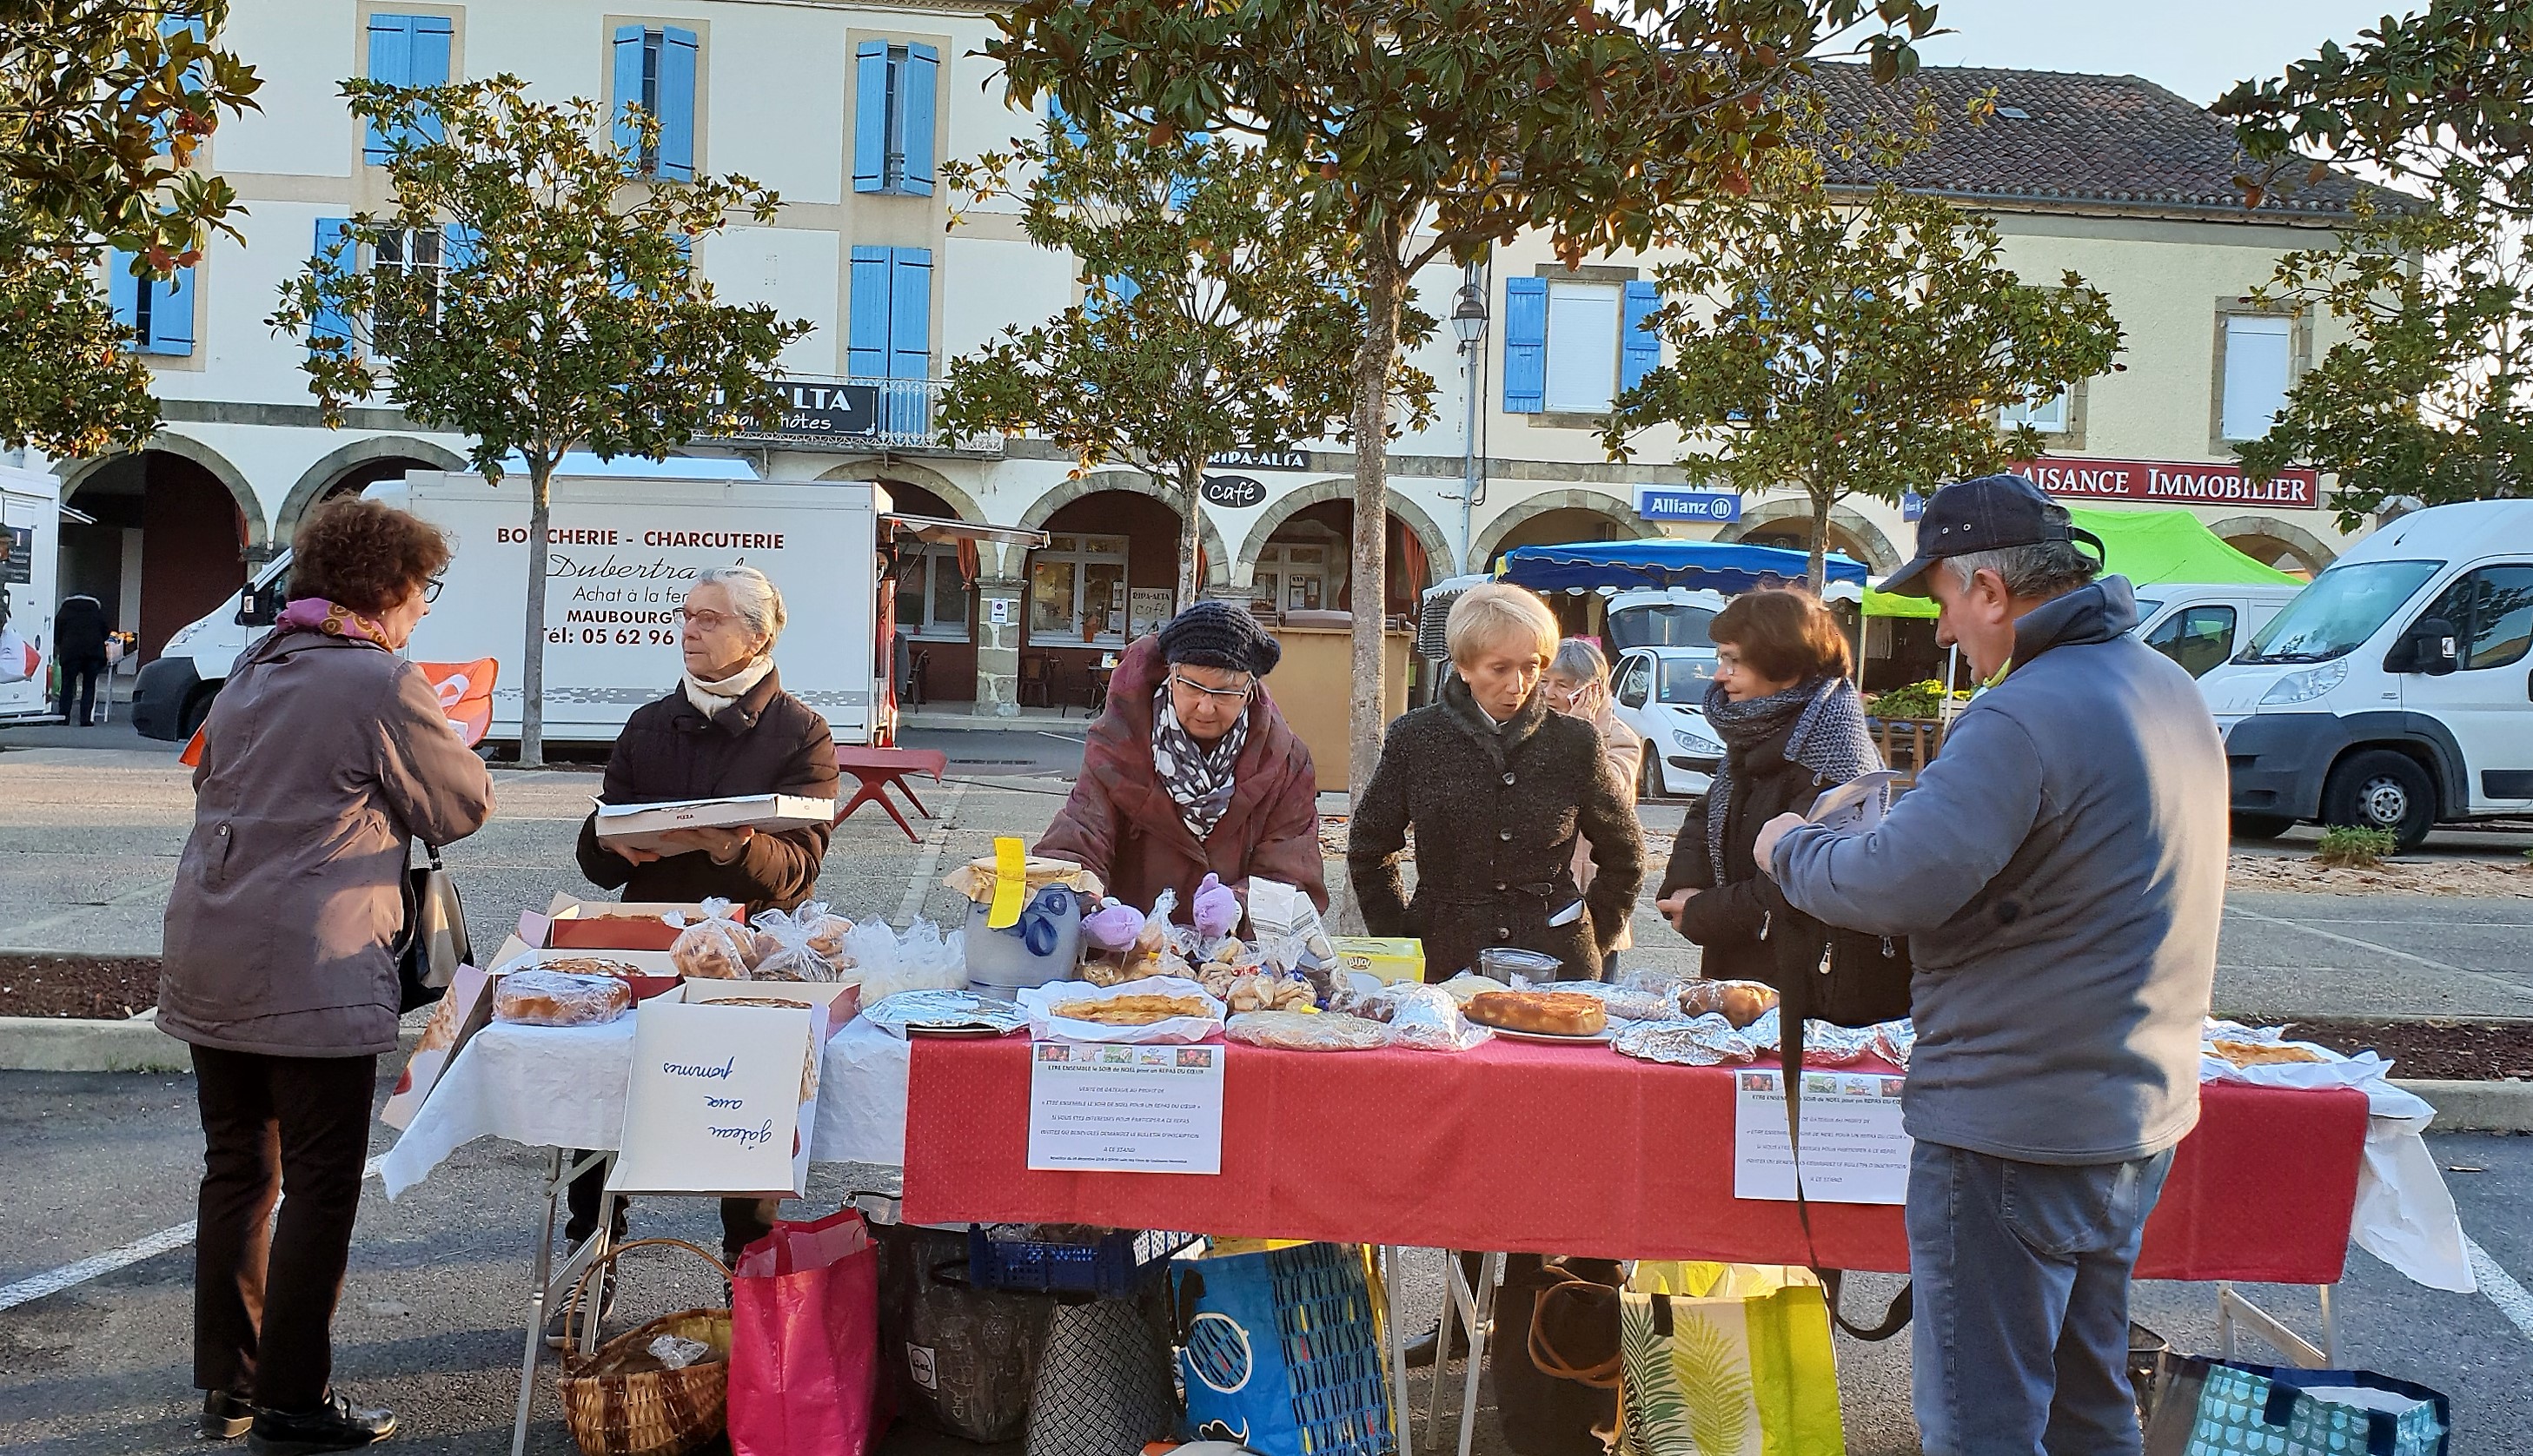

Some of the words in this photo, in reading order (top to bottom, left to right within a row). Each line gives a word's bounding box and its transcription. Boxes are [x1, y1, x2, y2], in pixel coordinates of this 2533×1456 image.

[1209, 481, 1255, 506] café
[2147, 468, 2308, 501] IMMOBILIER
[1651, 498, 1708, 514] Allianz
[497, 528, 618, 546] BOCHERIE
[644, 531, 785, 549] CHARCUTERIE
[546, 554, 745, 579] Dubertra
[573, 586, 623, 604] Achat
[627, 588, 638, 603] à
[644, 586, 659, 603] la
[666, 586, 689, 604] fer
[567, 610, 673, 625] MAUBOURG
[582, 628, 607, 645] 05
[615, 629, 640, 645] 62
[648, 629, 674, 645] 96
[663, 1056, 735, 1080] pommes
[703, 1095, 743, 1110] aux
[707, 1118, 772, 1150] gâteau
